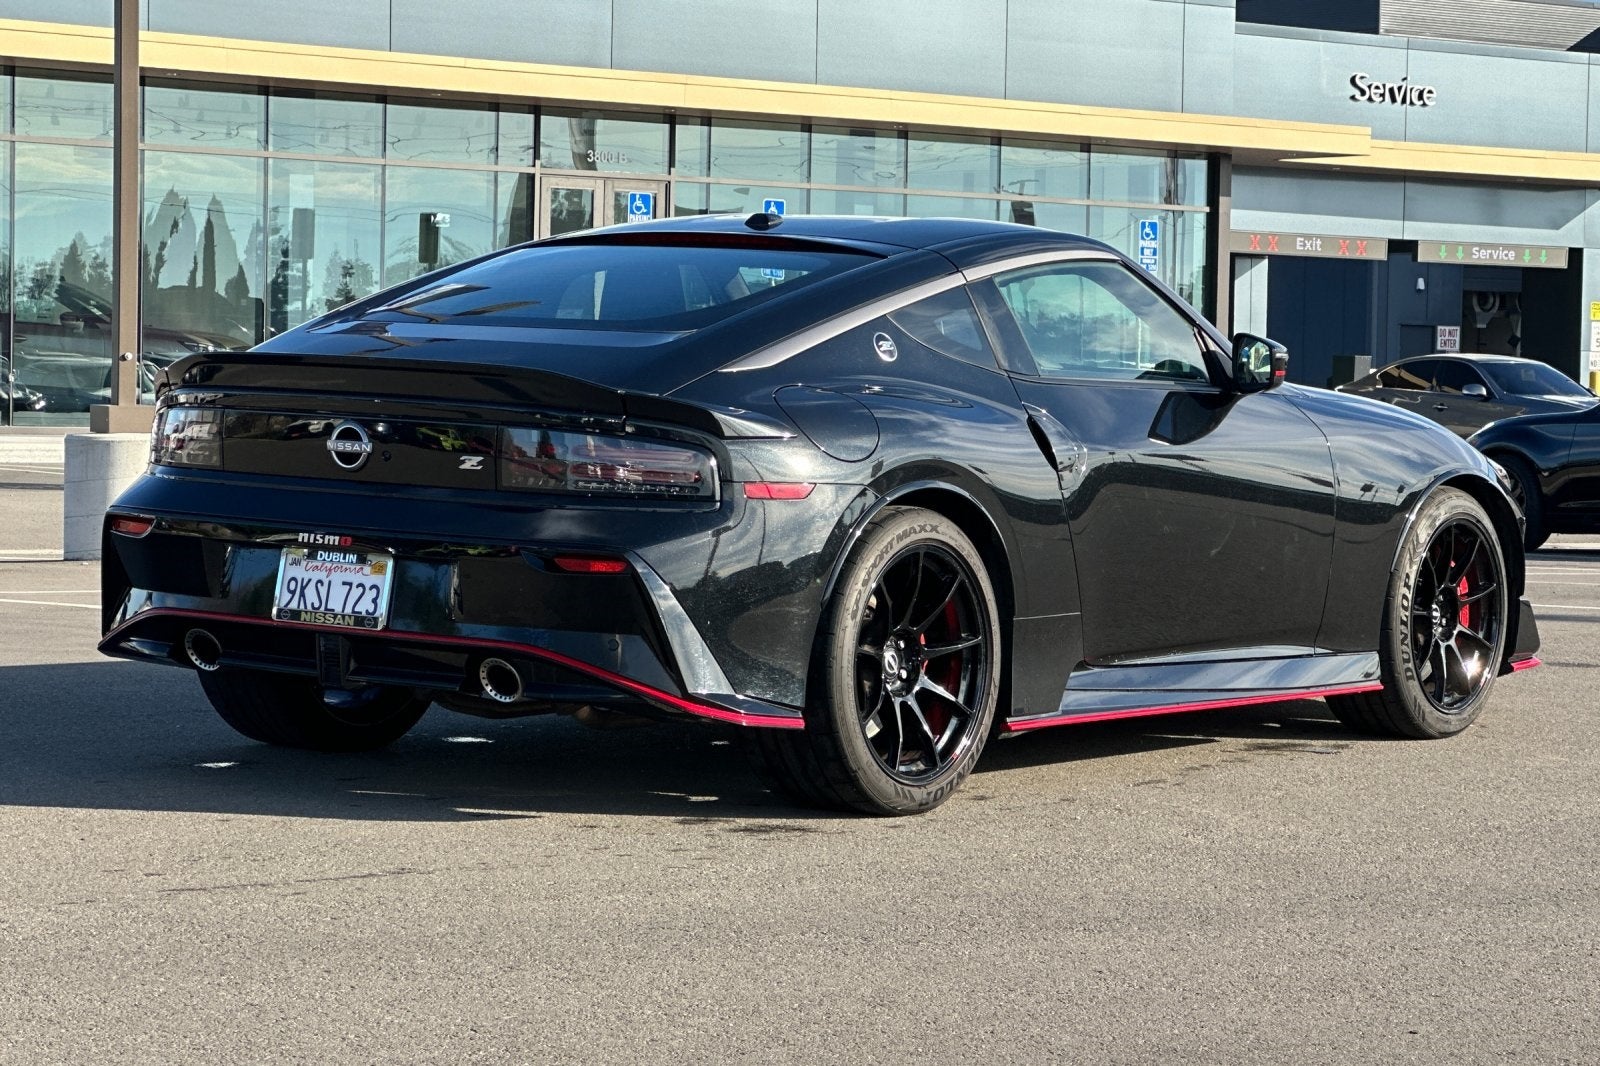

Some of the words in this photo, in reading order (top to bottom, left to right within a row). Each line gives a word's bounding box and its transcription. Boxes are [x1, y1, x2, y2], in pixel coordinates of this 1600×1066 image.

[1349, 72, 1437, 107] Service
[587, 149, 613, 163] 3800
[1296, 237, 1322, 251] Exit
[1472, 246, 1516, 261] Service
[1439, 328, 1447, 338] DO
[1448, 328, 1458, 338] NOT
[1440, 338, 1457, 349] ENTER
[327, 440, 372, 452] NISSAN
[458, 455, 485, 470] Z
[289, 557, 302, 567] JAN
[317, 550, 357, 563] DUBLIN
[304, 560, 370, 578] California
[283, 576, 380, 616] 9KSL723
[300, 611, 355, 626] NISSAN
[1400, 573, 1415, 681] DUNLOP
